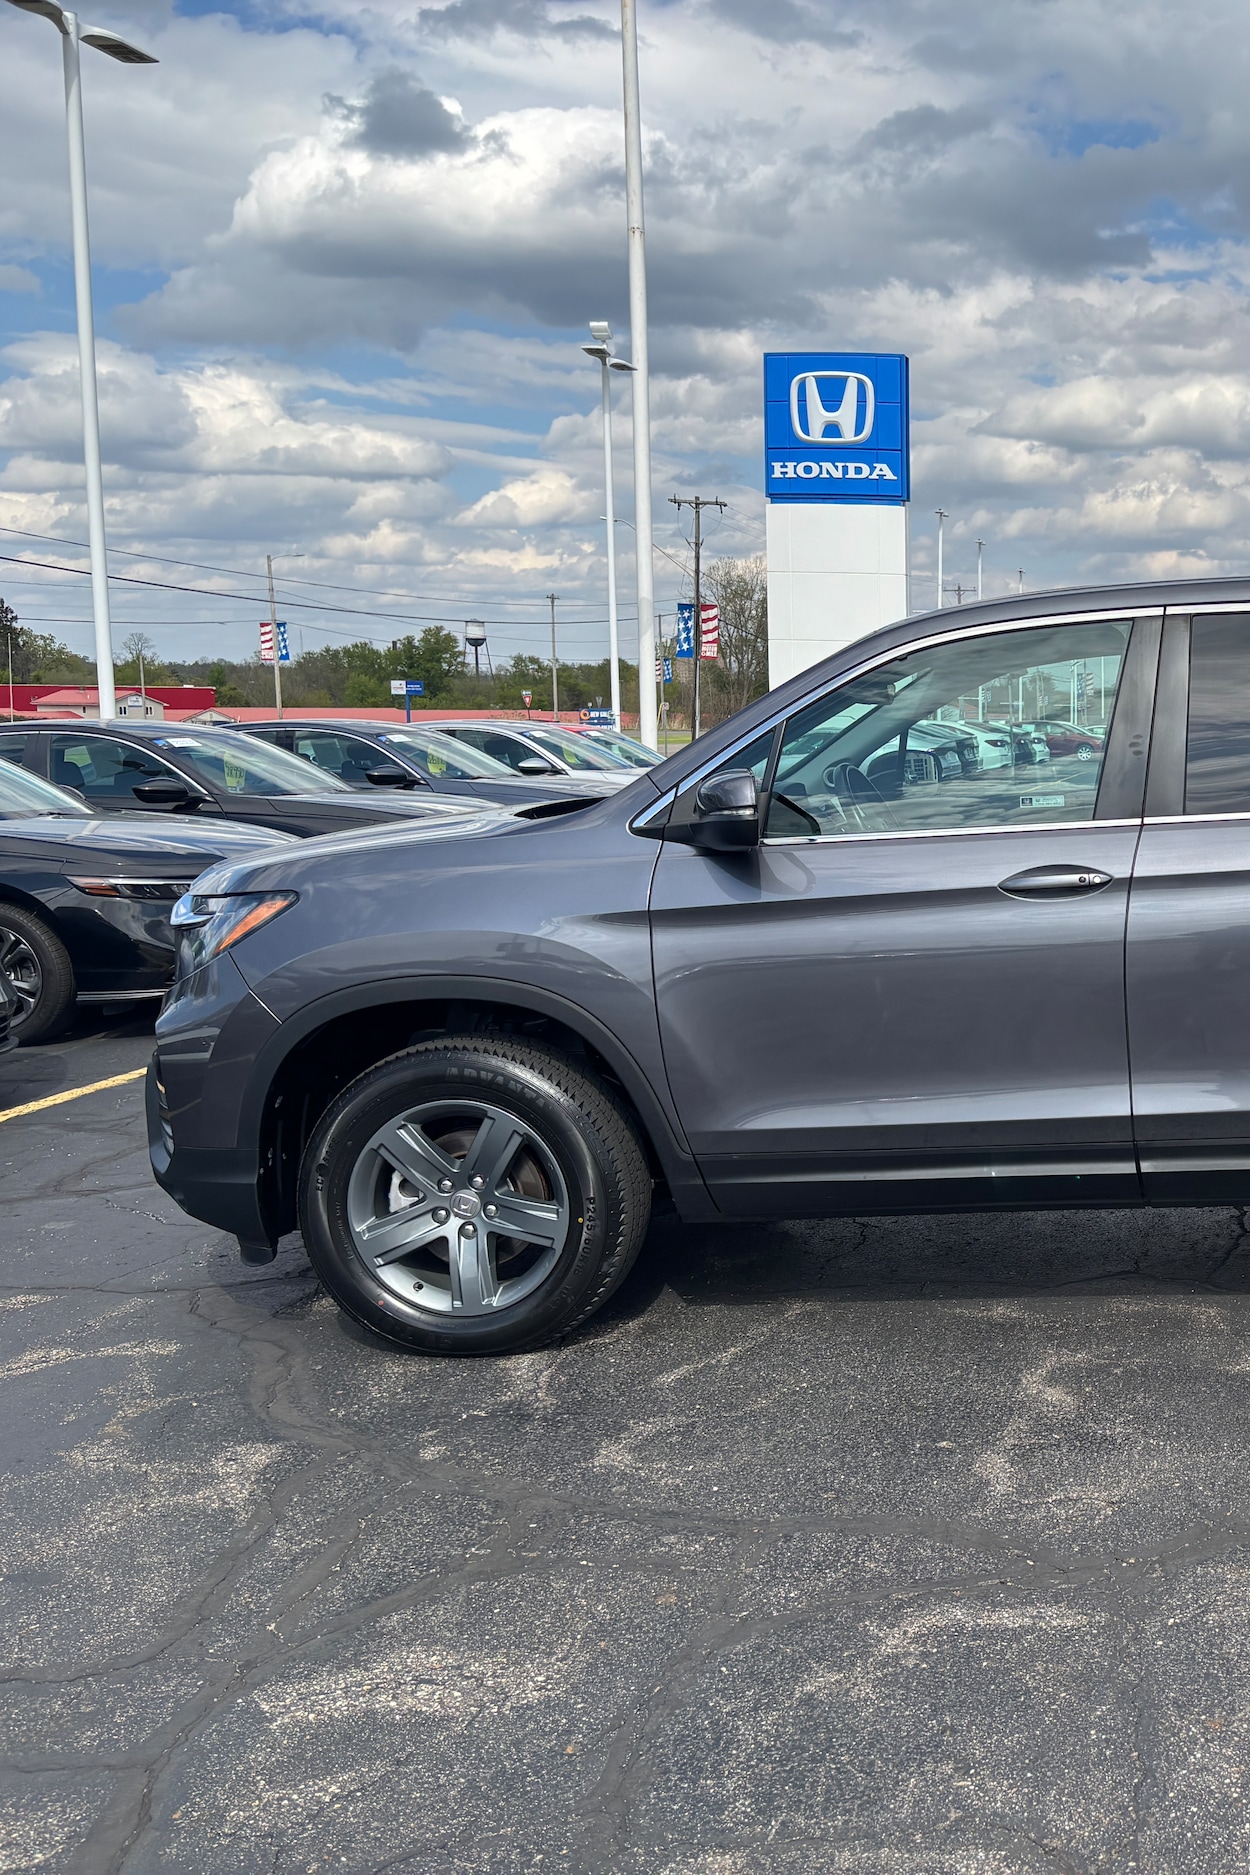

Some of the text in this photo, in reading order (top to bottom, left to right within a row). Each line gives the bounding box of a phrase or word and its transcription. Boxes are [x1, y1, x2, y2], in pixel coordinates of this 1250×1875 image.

[771, 461, 898, 480] HONDA
[445, 1066, 547, 1108] ADVANTA
[574, 1197, 596, 1276] P245/60R18
